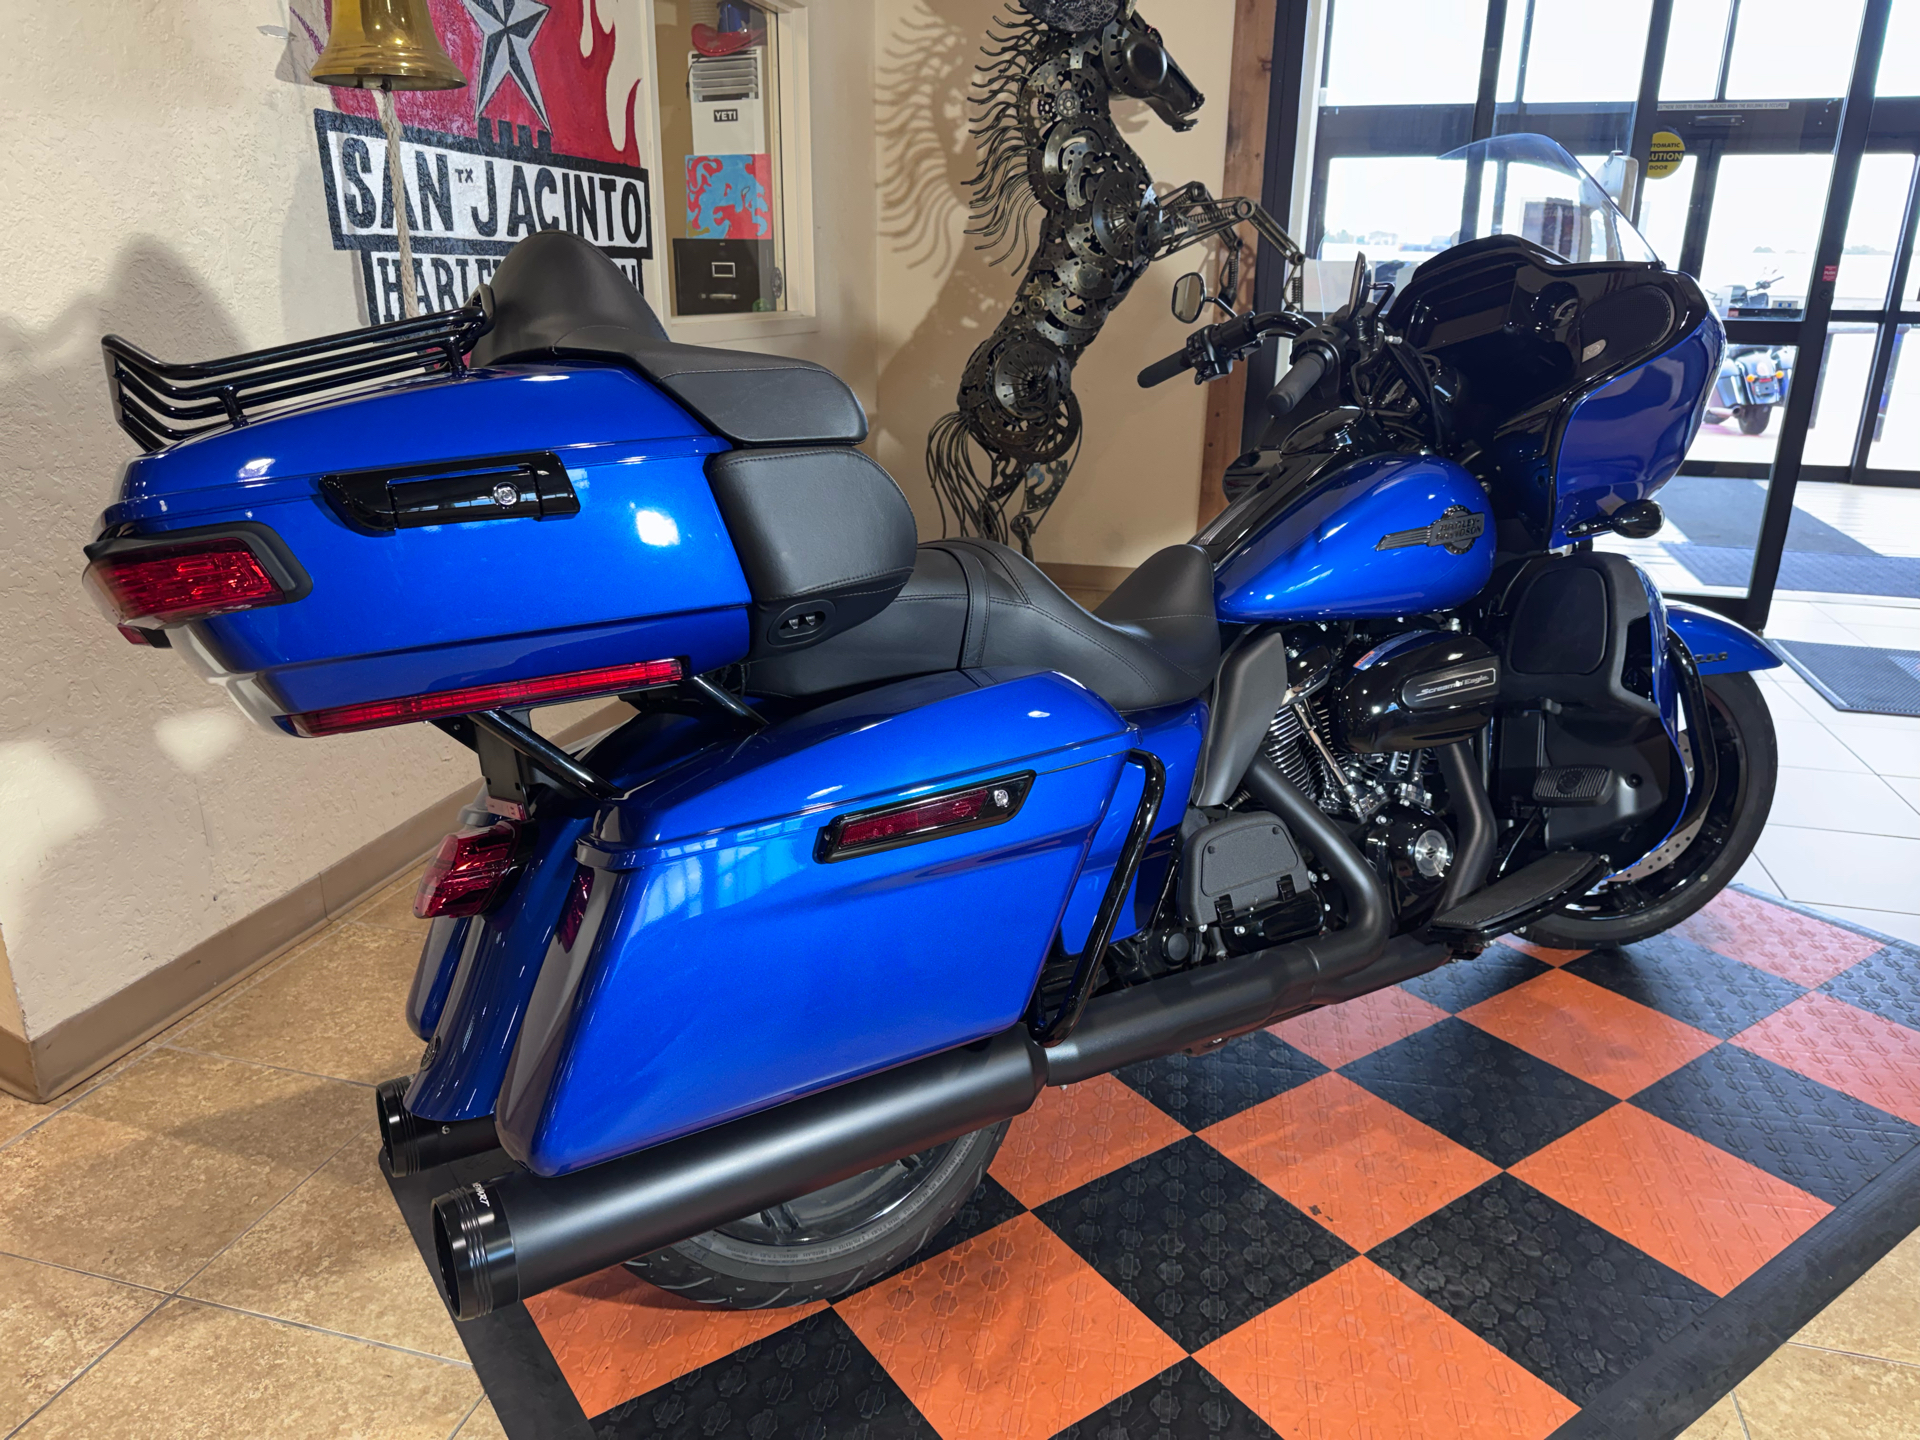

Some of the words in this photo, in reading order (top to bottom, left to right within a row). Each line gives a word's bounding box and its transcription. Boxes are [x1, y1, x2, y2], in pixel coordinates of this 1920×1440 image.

[715, 111, 737, 120] YETI
[342, 138, 453, 231] SAN
[455, 168, 474, 184] TX
[471, 160, 643, 243] JACINTO
